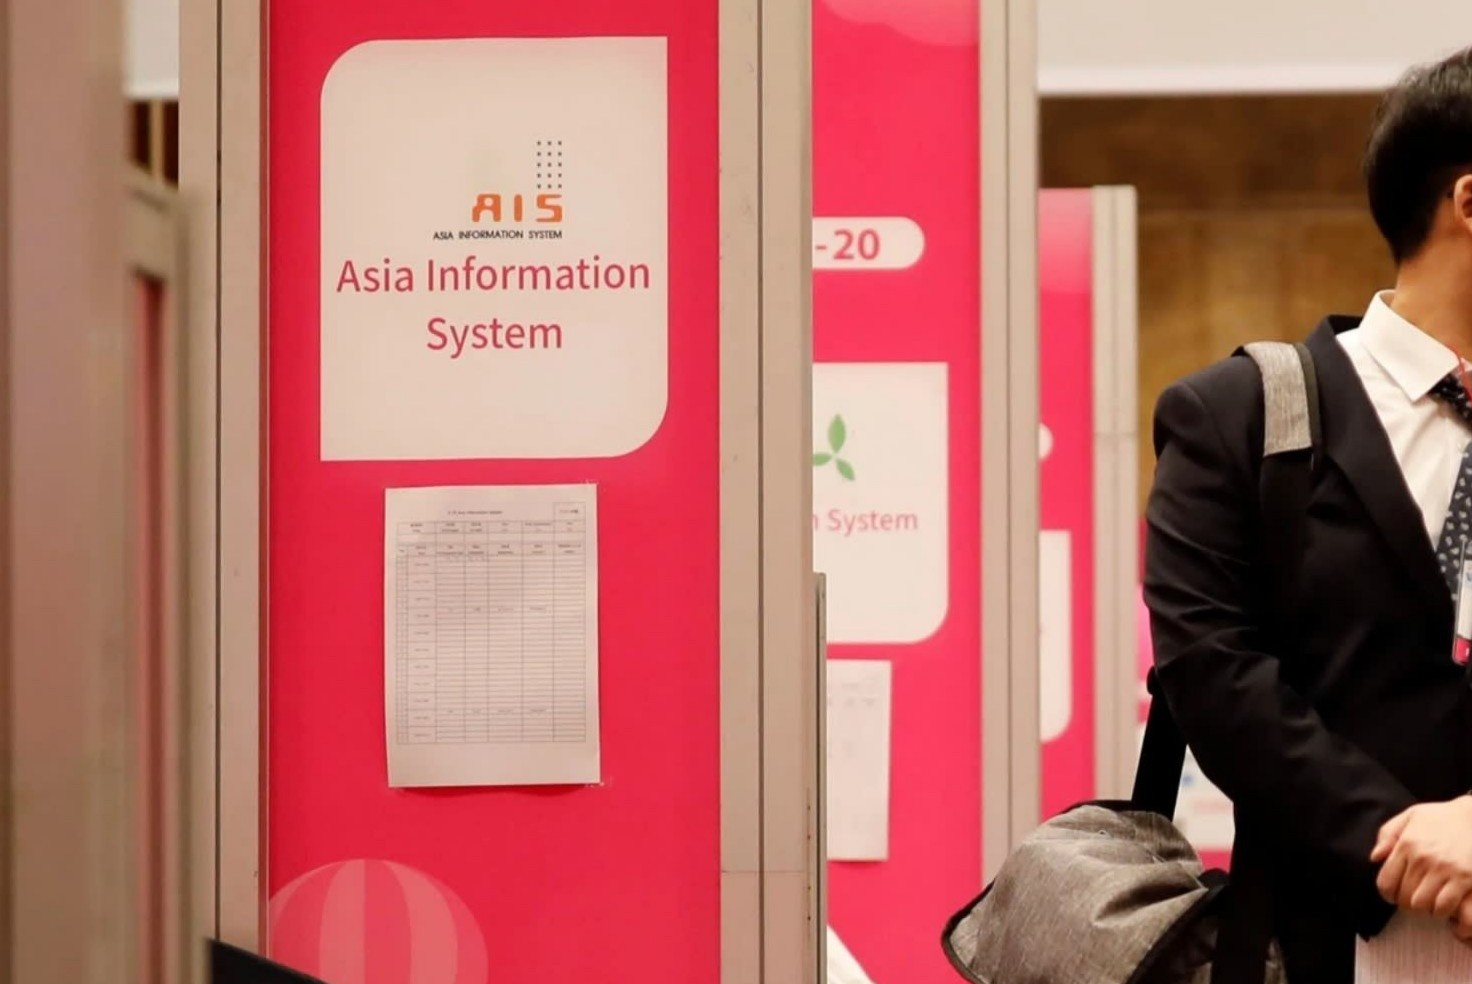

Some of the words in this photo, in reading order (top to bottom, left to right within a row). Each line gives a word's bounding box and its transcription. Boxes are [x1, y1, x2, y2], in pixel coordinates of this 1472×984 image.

[471, 193, 563, 223] AIS
[433, 231, 454, 241] ASIA
[458, 230, 525, 240] INFORMATION
[528, 230, 563, 240] SYSTEM
[814, 228, 880, 261] -20
[336, 259, 415, 293] Asia
[427, 255, 651, 292] Information
[427, 317, 563, 359] System
[827, 508, 919, 538] System
